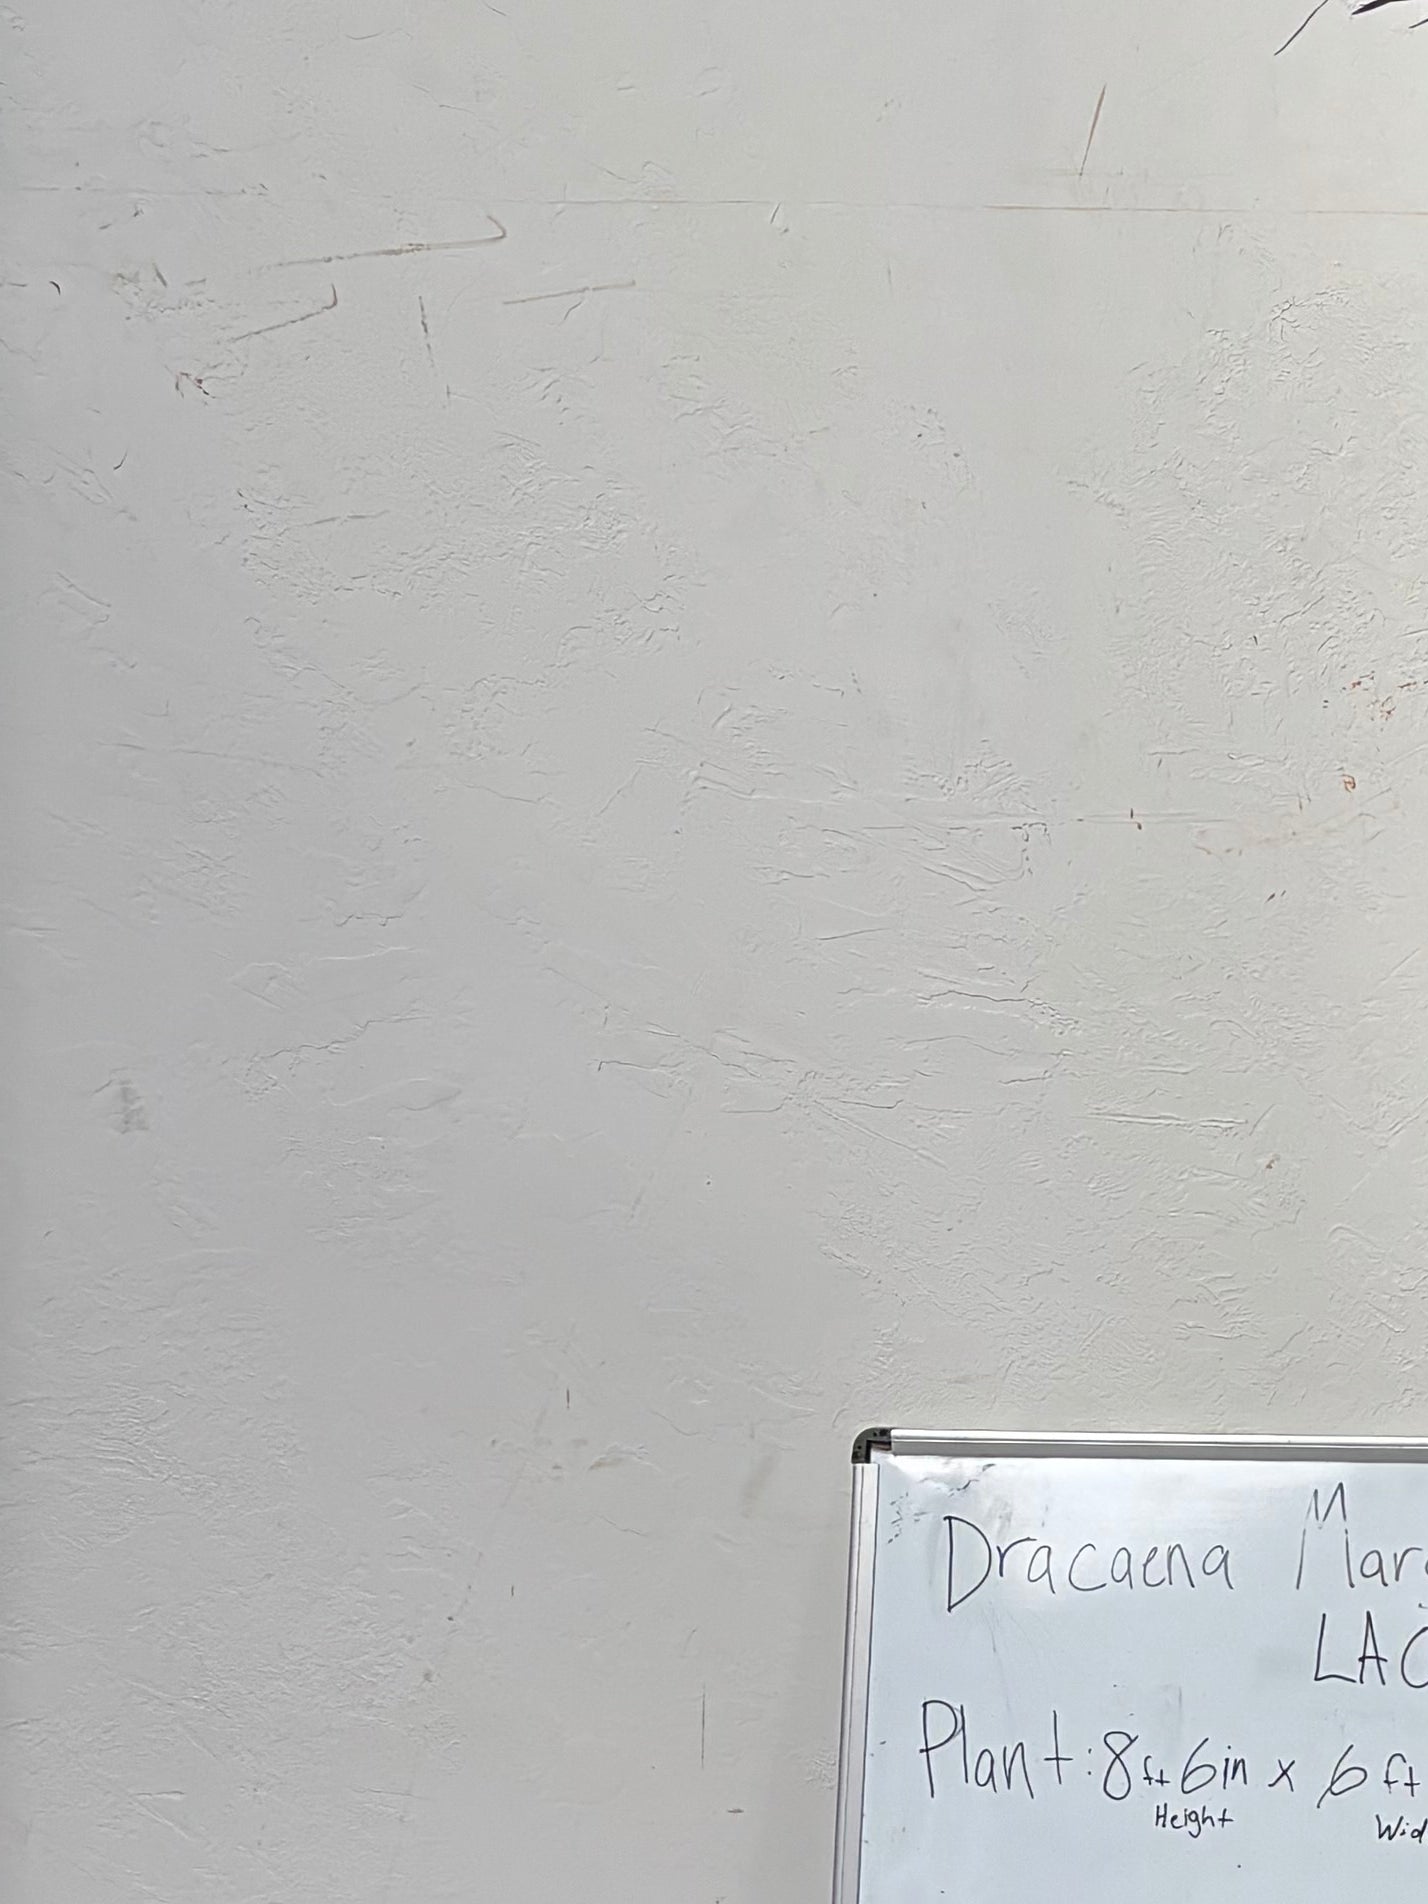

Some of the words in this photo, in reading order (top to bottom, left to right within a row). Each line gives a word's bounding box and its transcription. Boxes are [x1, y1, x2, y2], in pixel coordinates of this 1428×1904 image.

[942, 1515, 1235, 1614] Dracaena
[918, 1699, 1093, 1800] Plant:
[1154, 1802, 1235, 1839] Height
